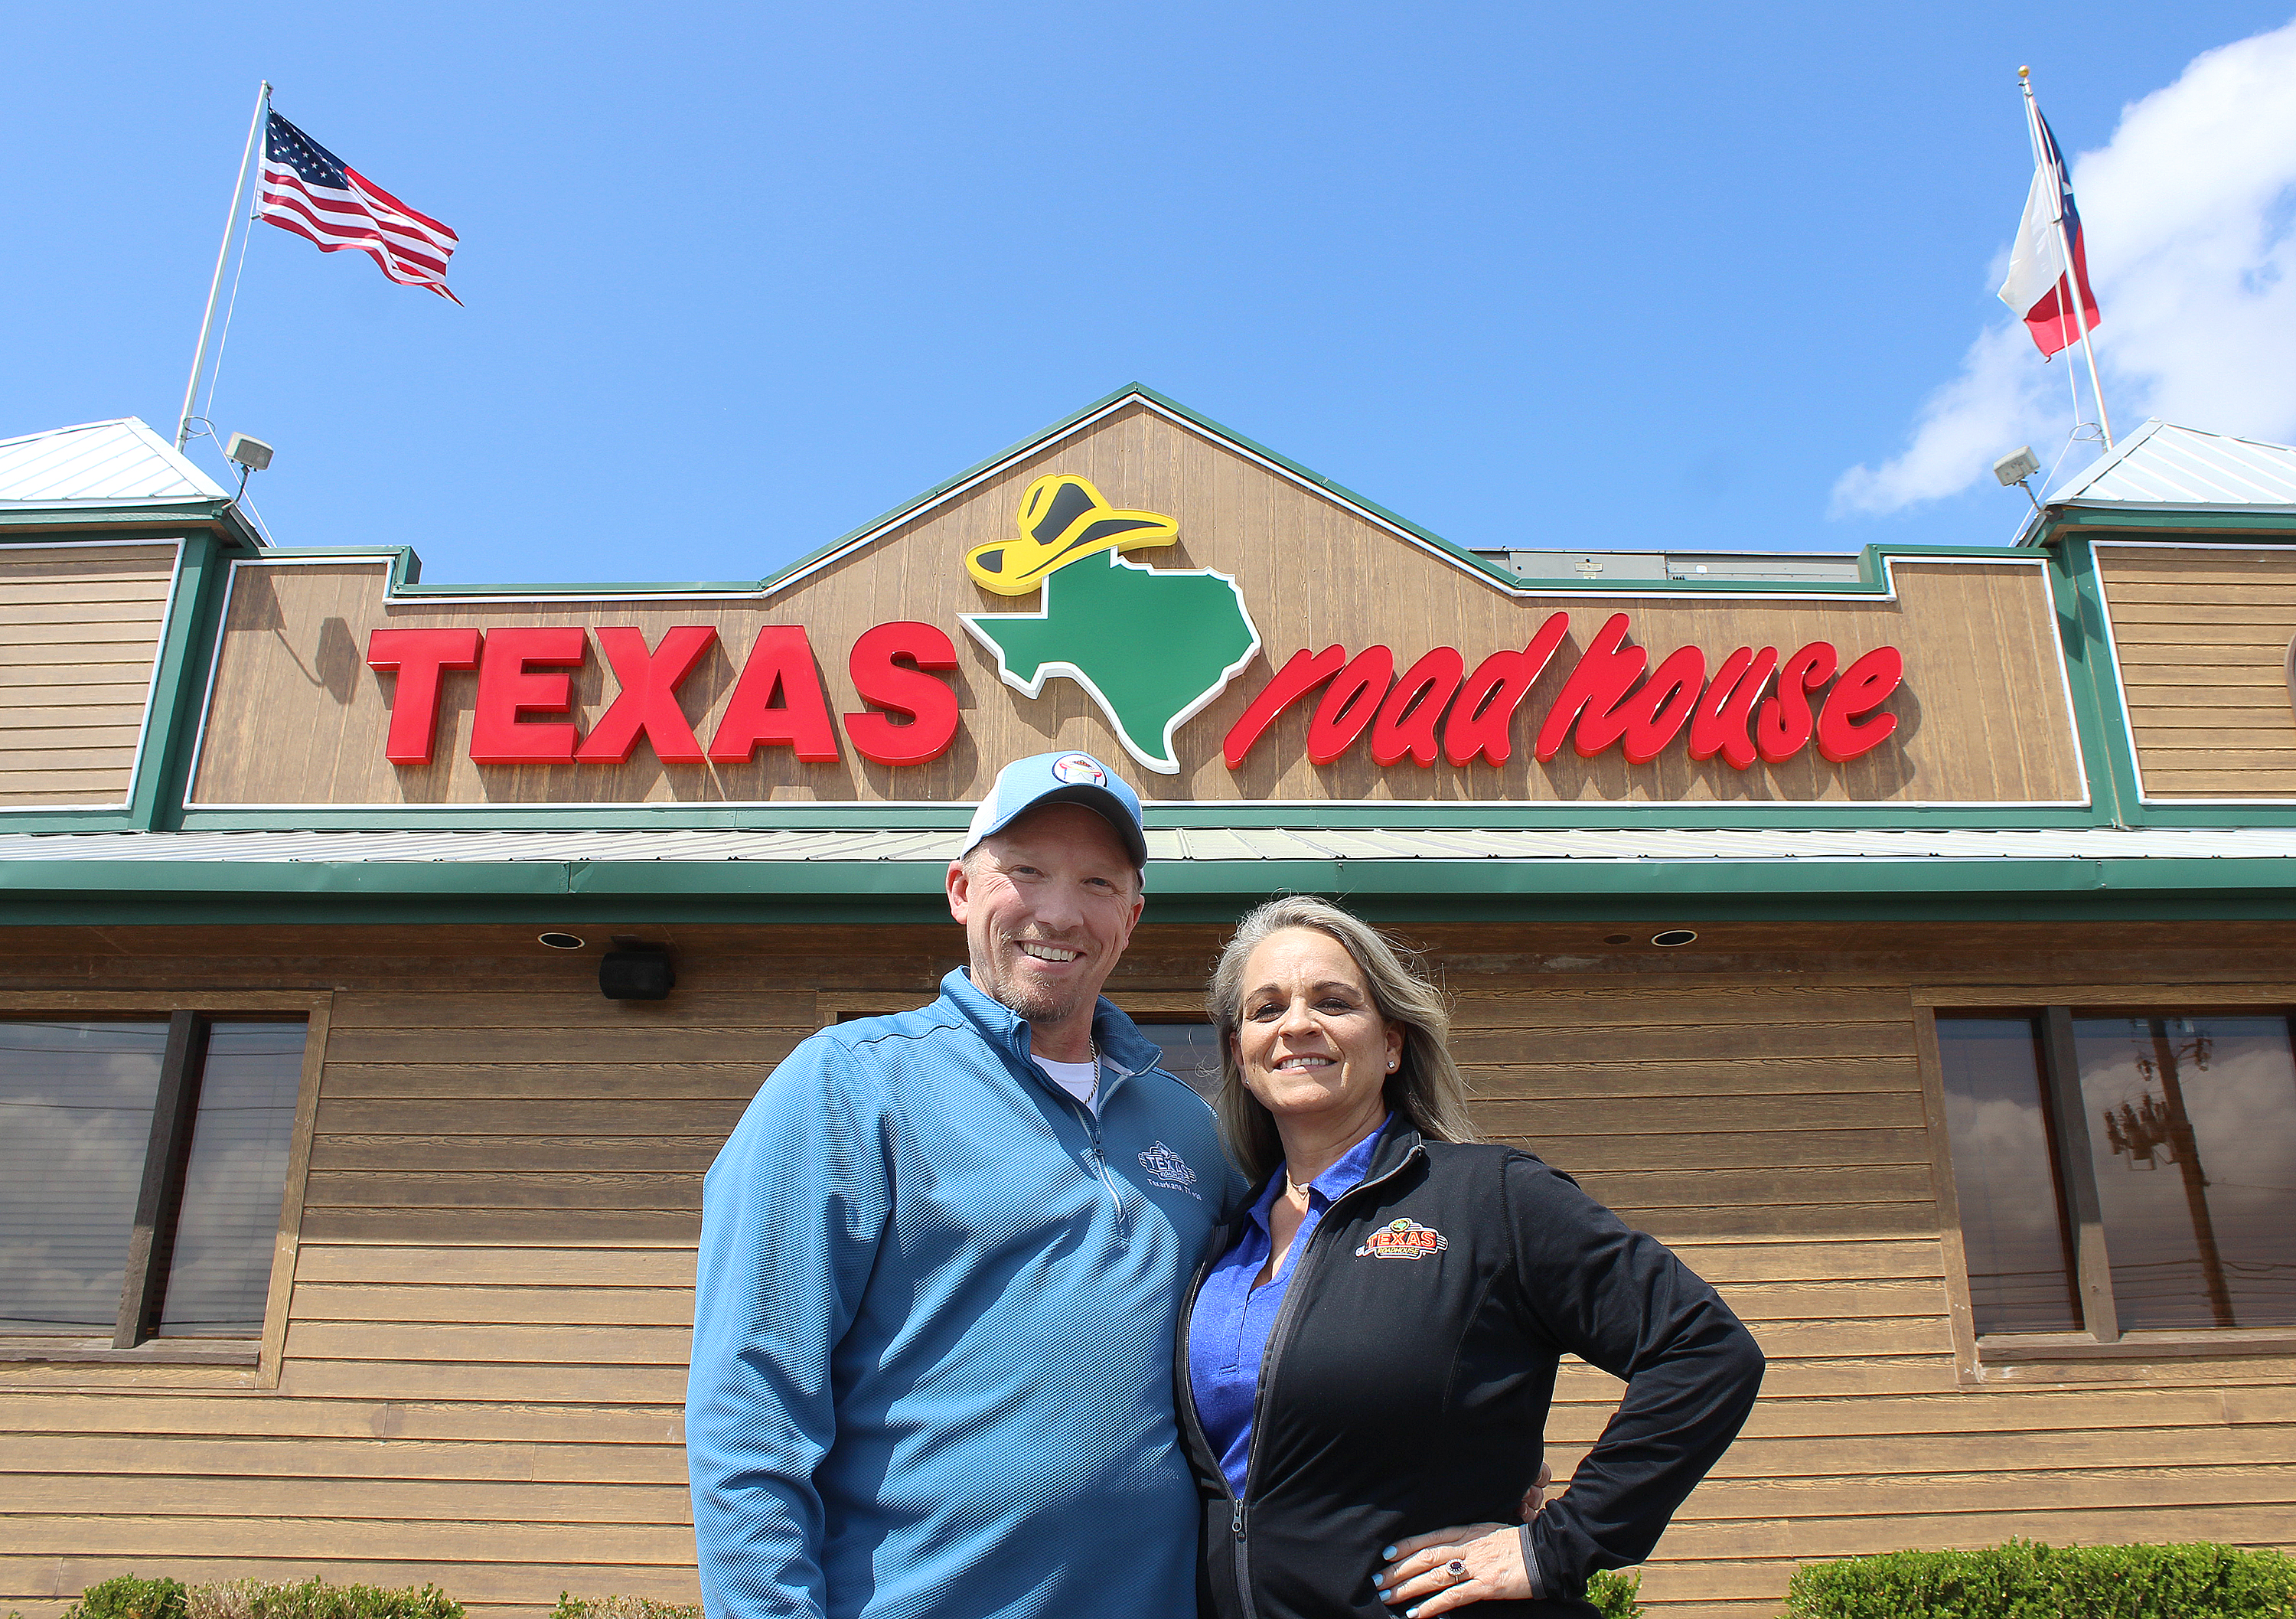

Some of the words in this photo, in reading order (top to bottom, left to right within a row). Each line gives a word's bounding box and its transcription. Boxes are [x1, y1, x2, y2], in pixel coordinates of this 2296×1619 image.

[367, 621, 959, 765] TEXAS
[1145, 1156, 1189, 1177] TEXAS
[1367, 1231, 1437, 1249] TEXAS
